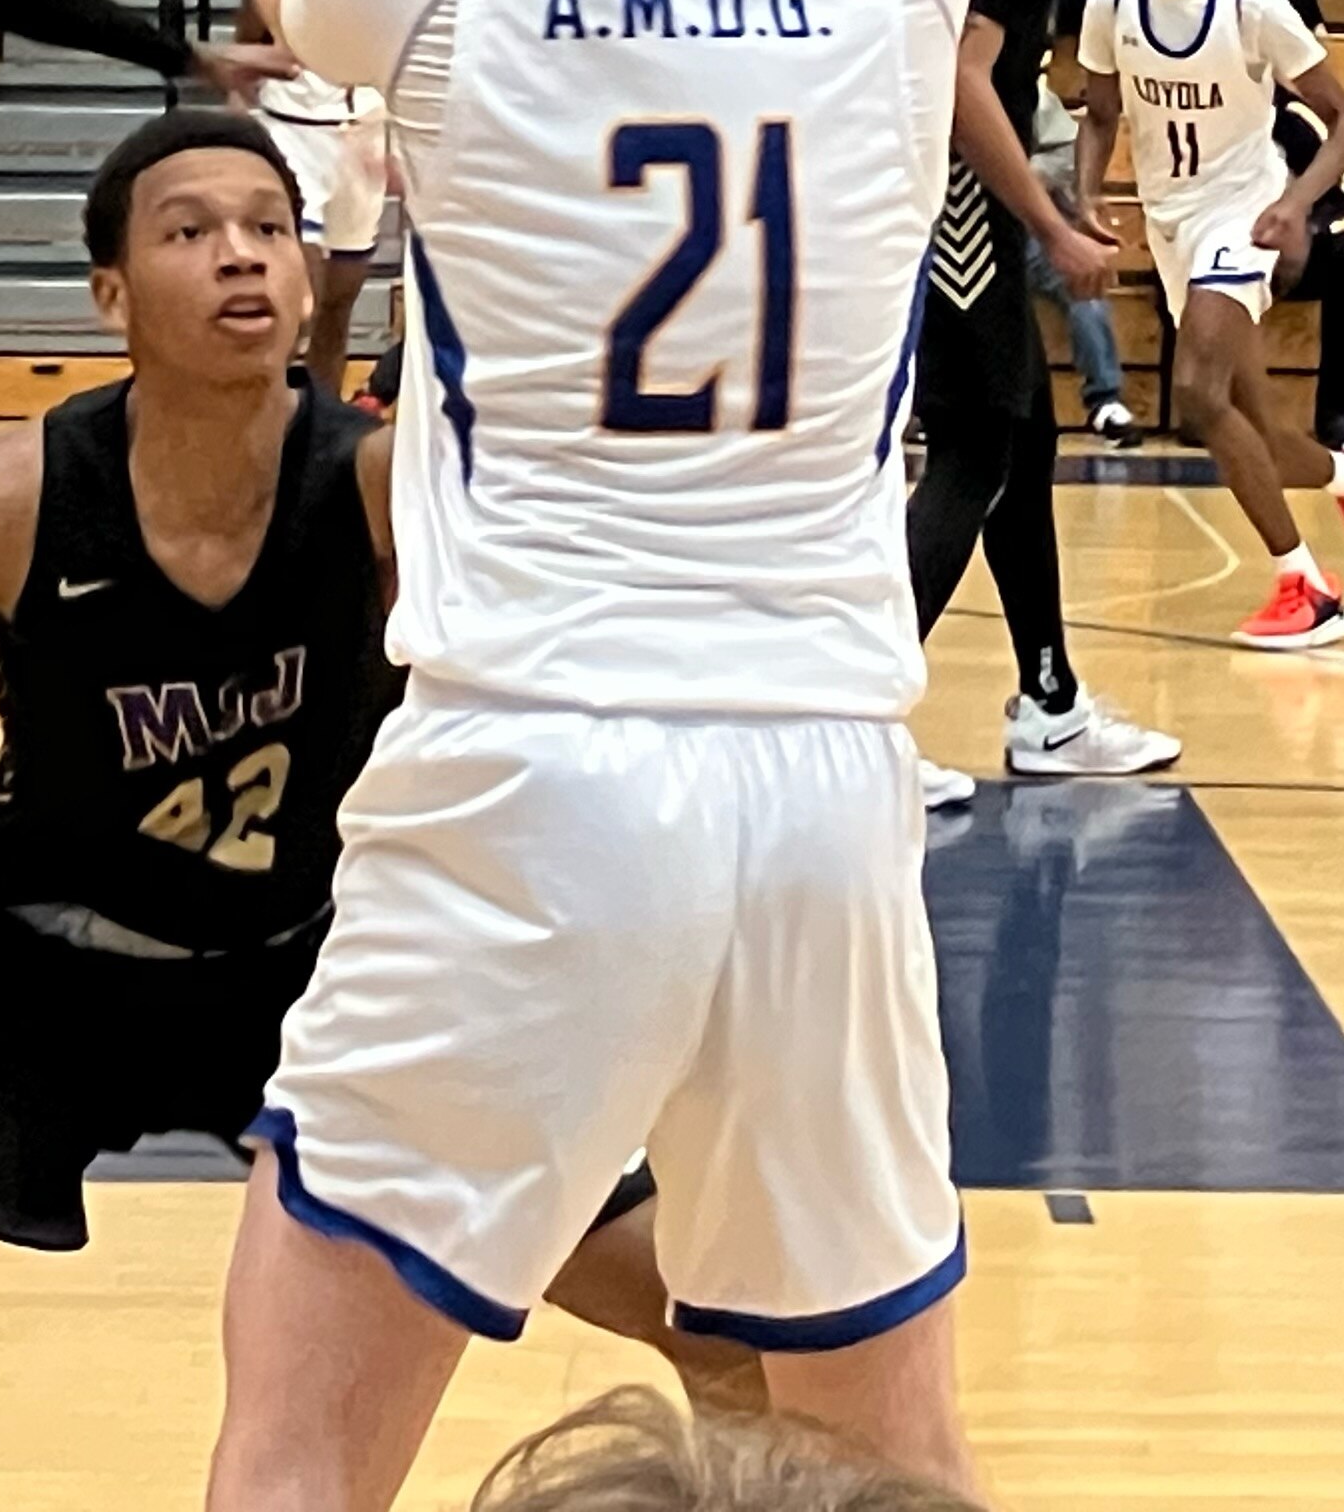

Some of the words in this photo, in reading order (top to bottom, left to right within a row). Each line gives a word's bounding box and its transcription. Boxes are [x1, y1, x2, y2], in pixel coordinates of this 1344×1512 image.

[1133, 75, 1224, 110] LOYOLA
[1168, 120, 1199, 178] 11
[601, 113, 798, 434] 21
[137, 742, 291, 871] 42
